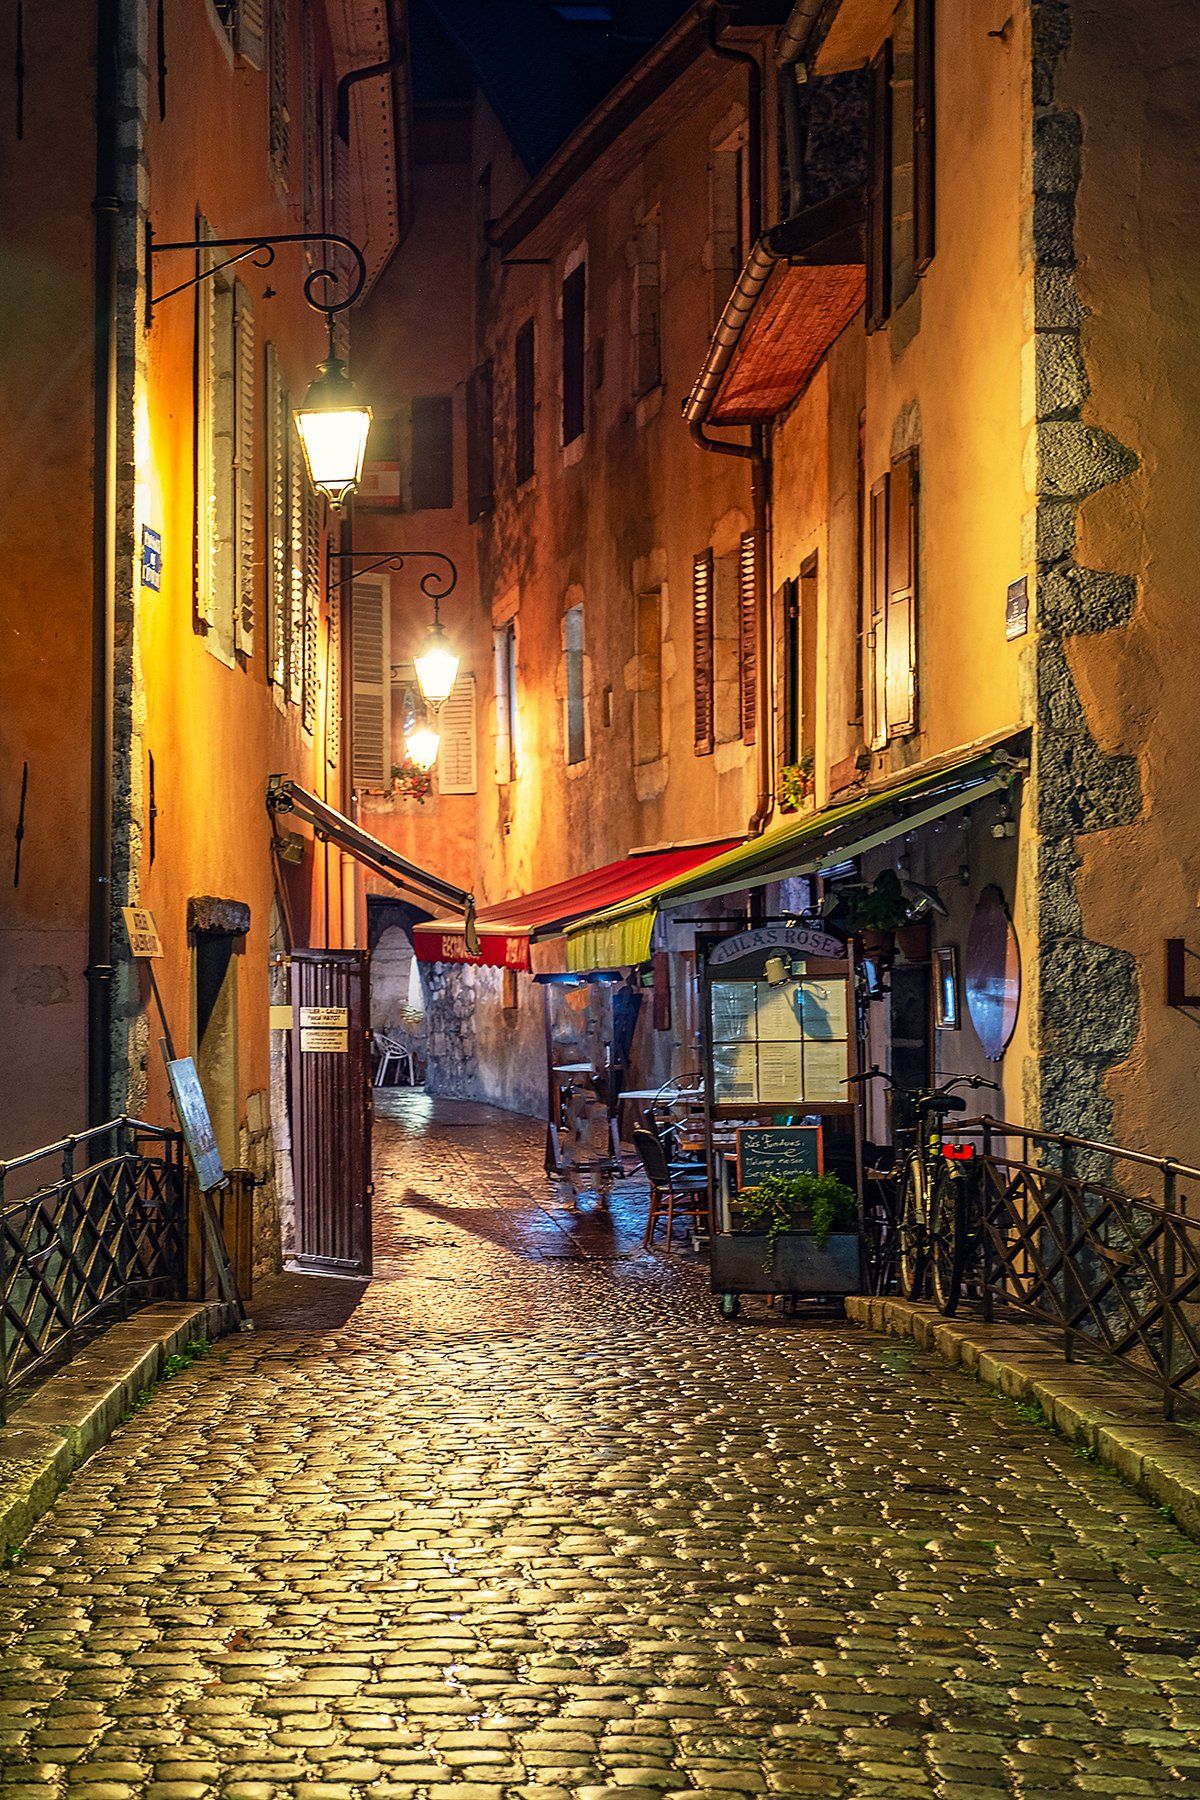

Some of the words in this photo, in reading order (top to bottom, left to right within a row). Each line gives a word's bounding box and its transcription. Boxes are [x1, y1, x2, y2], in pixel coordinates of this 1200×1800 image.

[721, 930, 777, 958] LILAS
[784, 930, 834, 952] ROSE
[743, 1134, 760, 1149] Les
